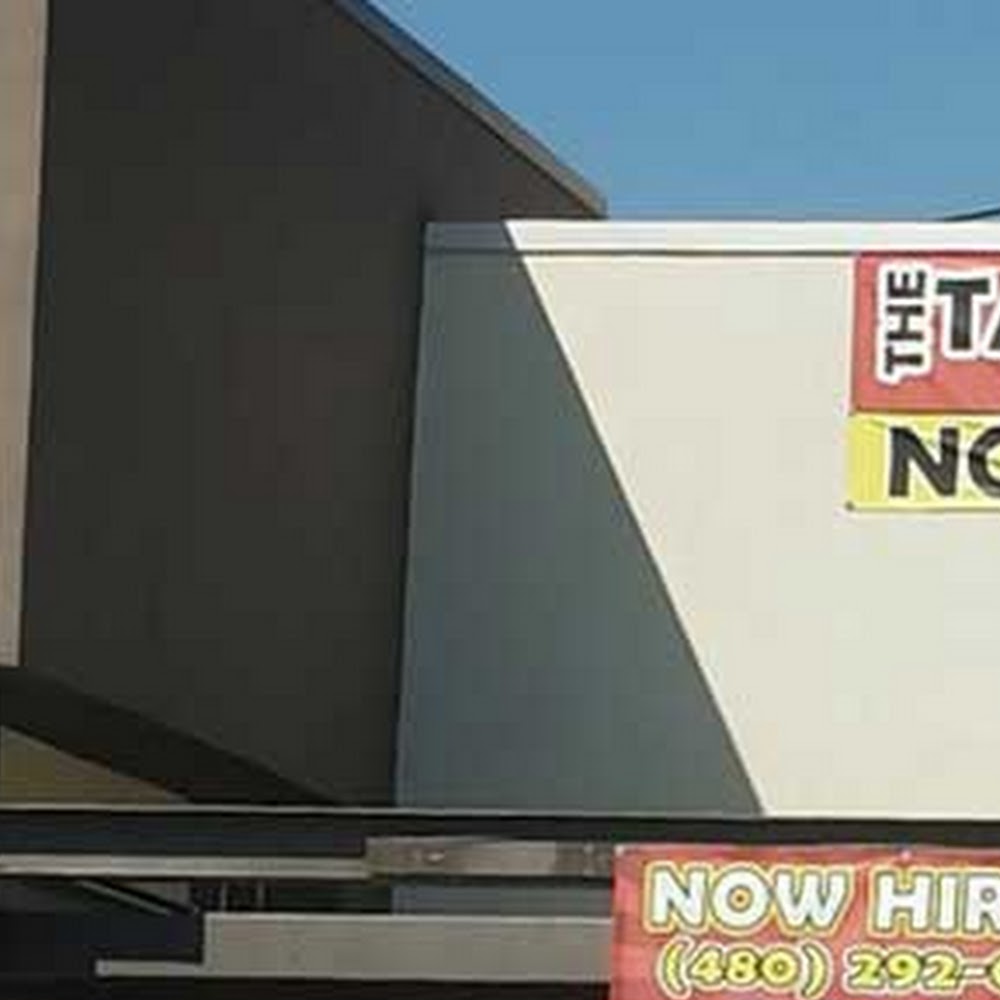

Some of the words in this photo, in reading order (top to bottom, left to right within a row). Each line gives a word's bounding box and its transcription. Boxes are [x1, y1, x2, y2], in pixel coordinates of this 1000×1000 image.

[884, 268, 927, 376] THE
[650, 865, 850, 933] NOW
[660, 941, 828, 997] (480)
